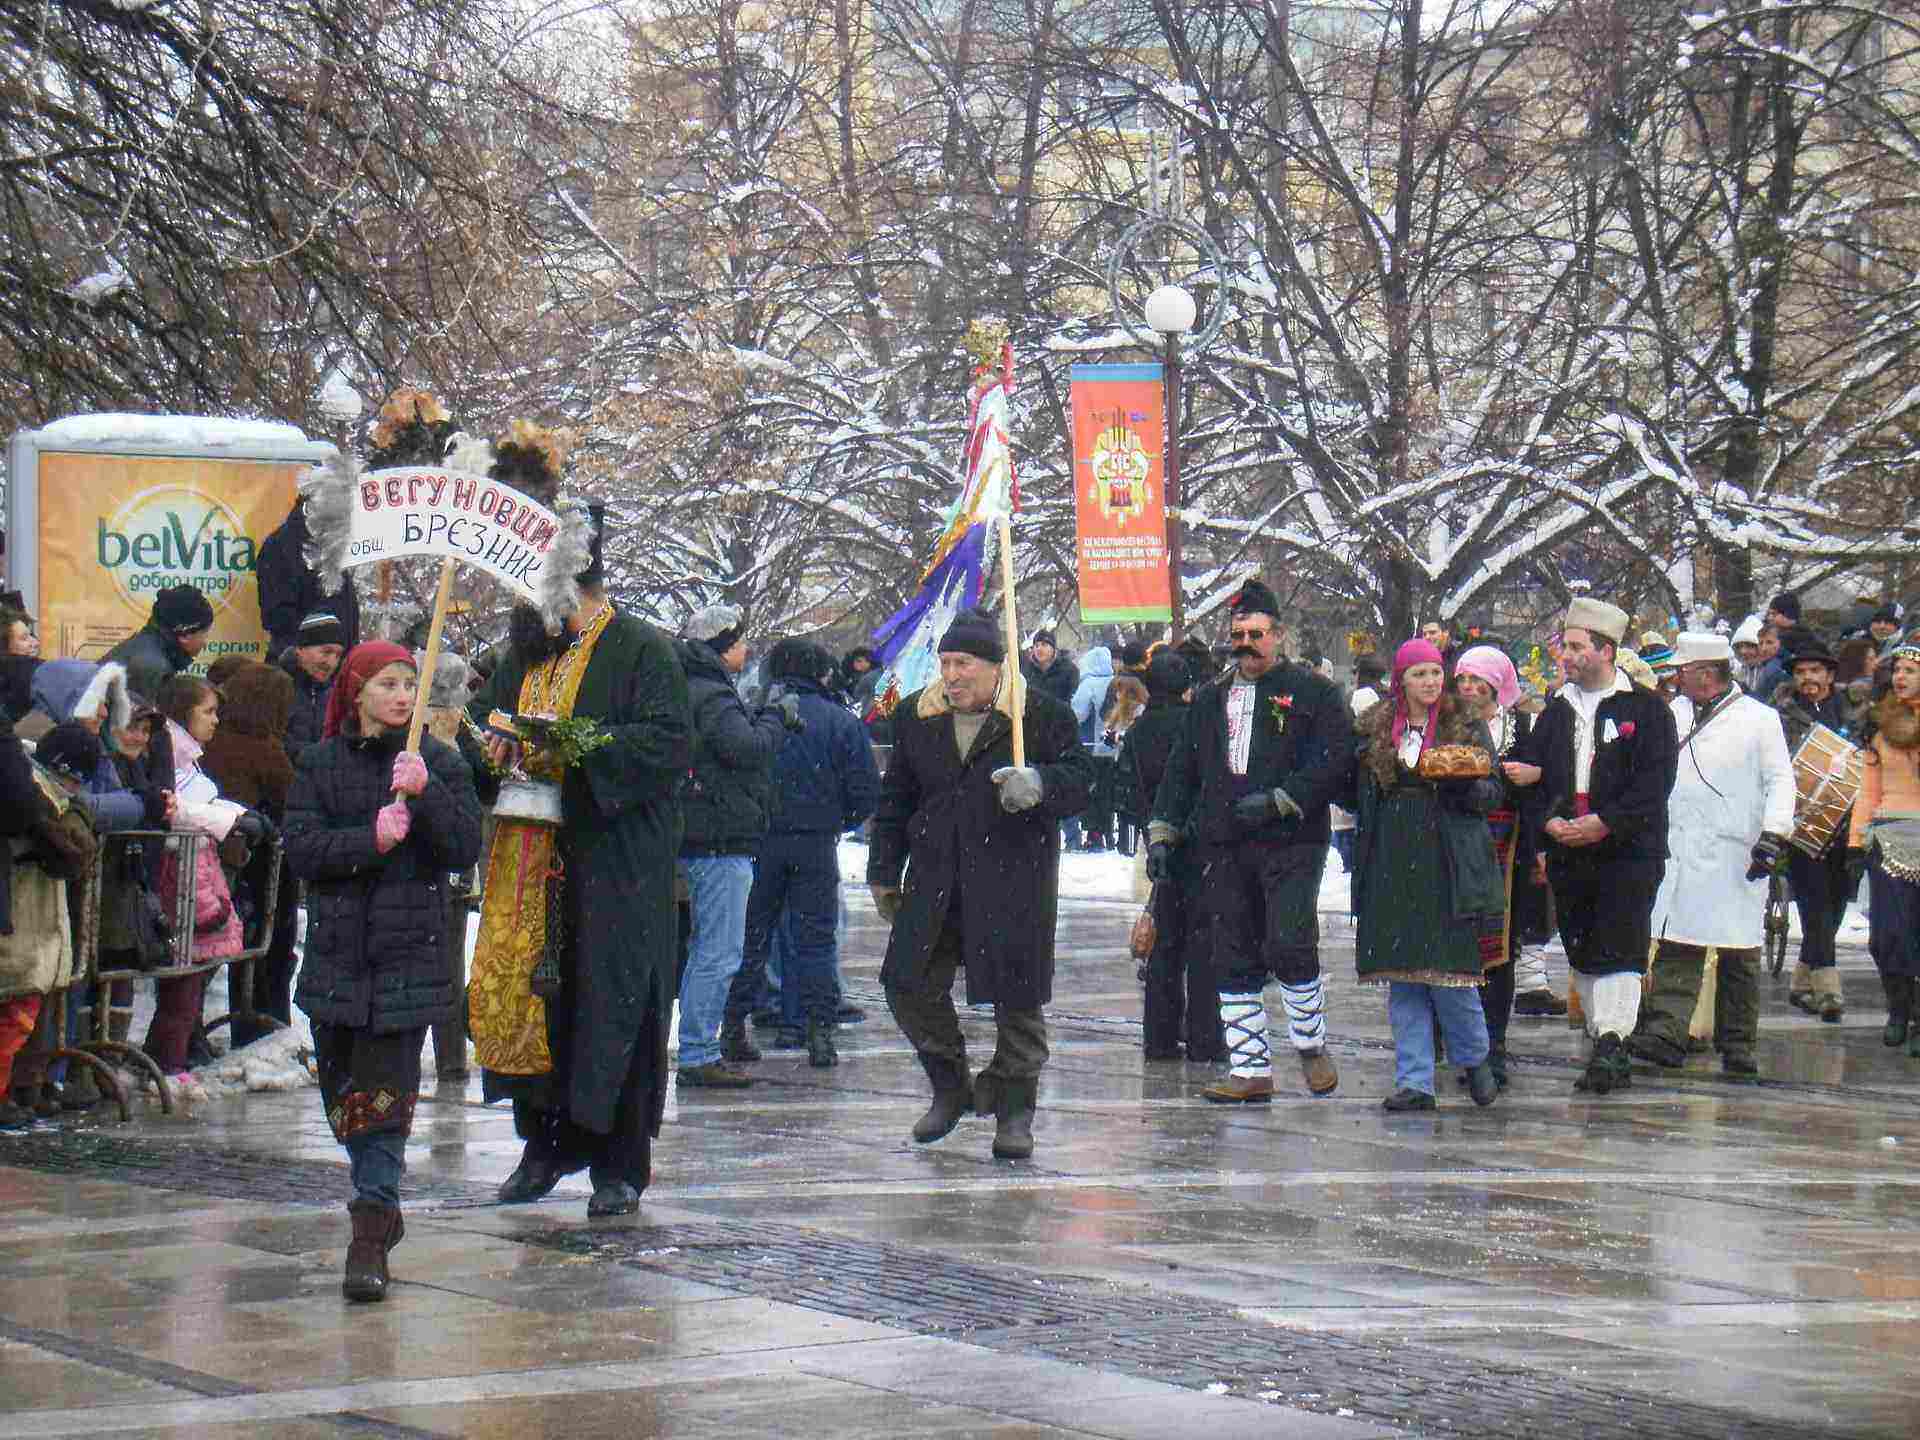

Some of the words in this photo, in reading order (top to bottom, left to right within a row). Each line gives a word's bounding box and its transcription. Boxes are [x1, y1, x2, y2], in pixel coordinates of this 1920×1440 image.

[96, 507, 258, 572] belVita
[360, 474, 560, 553] БЕГУНОВЦИ
[401, 513, 544, 591] БРЕЗНИК
